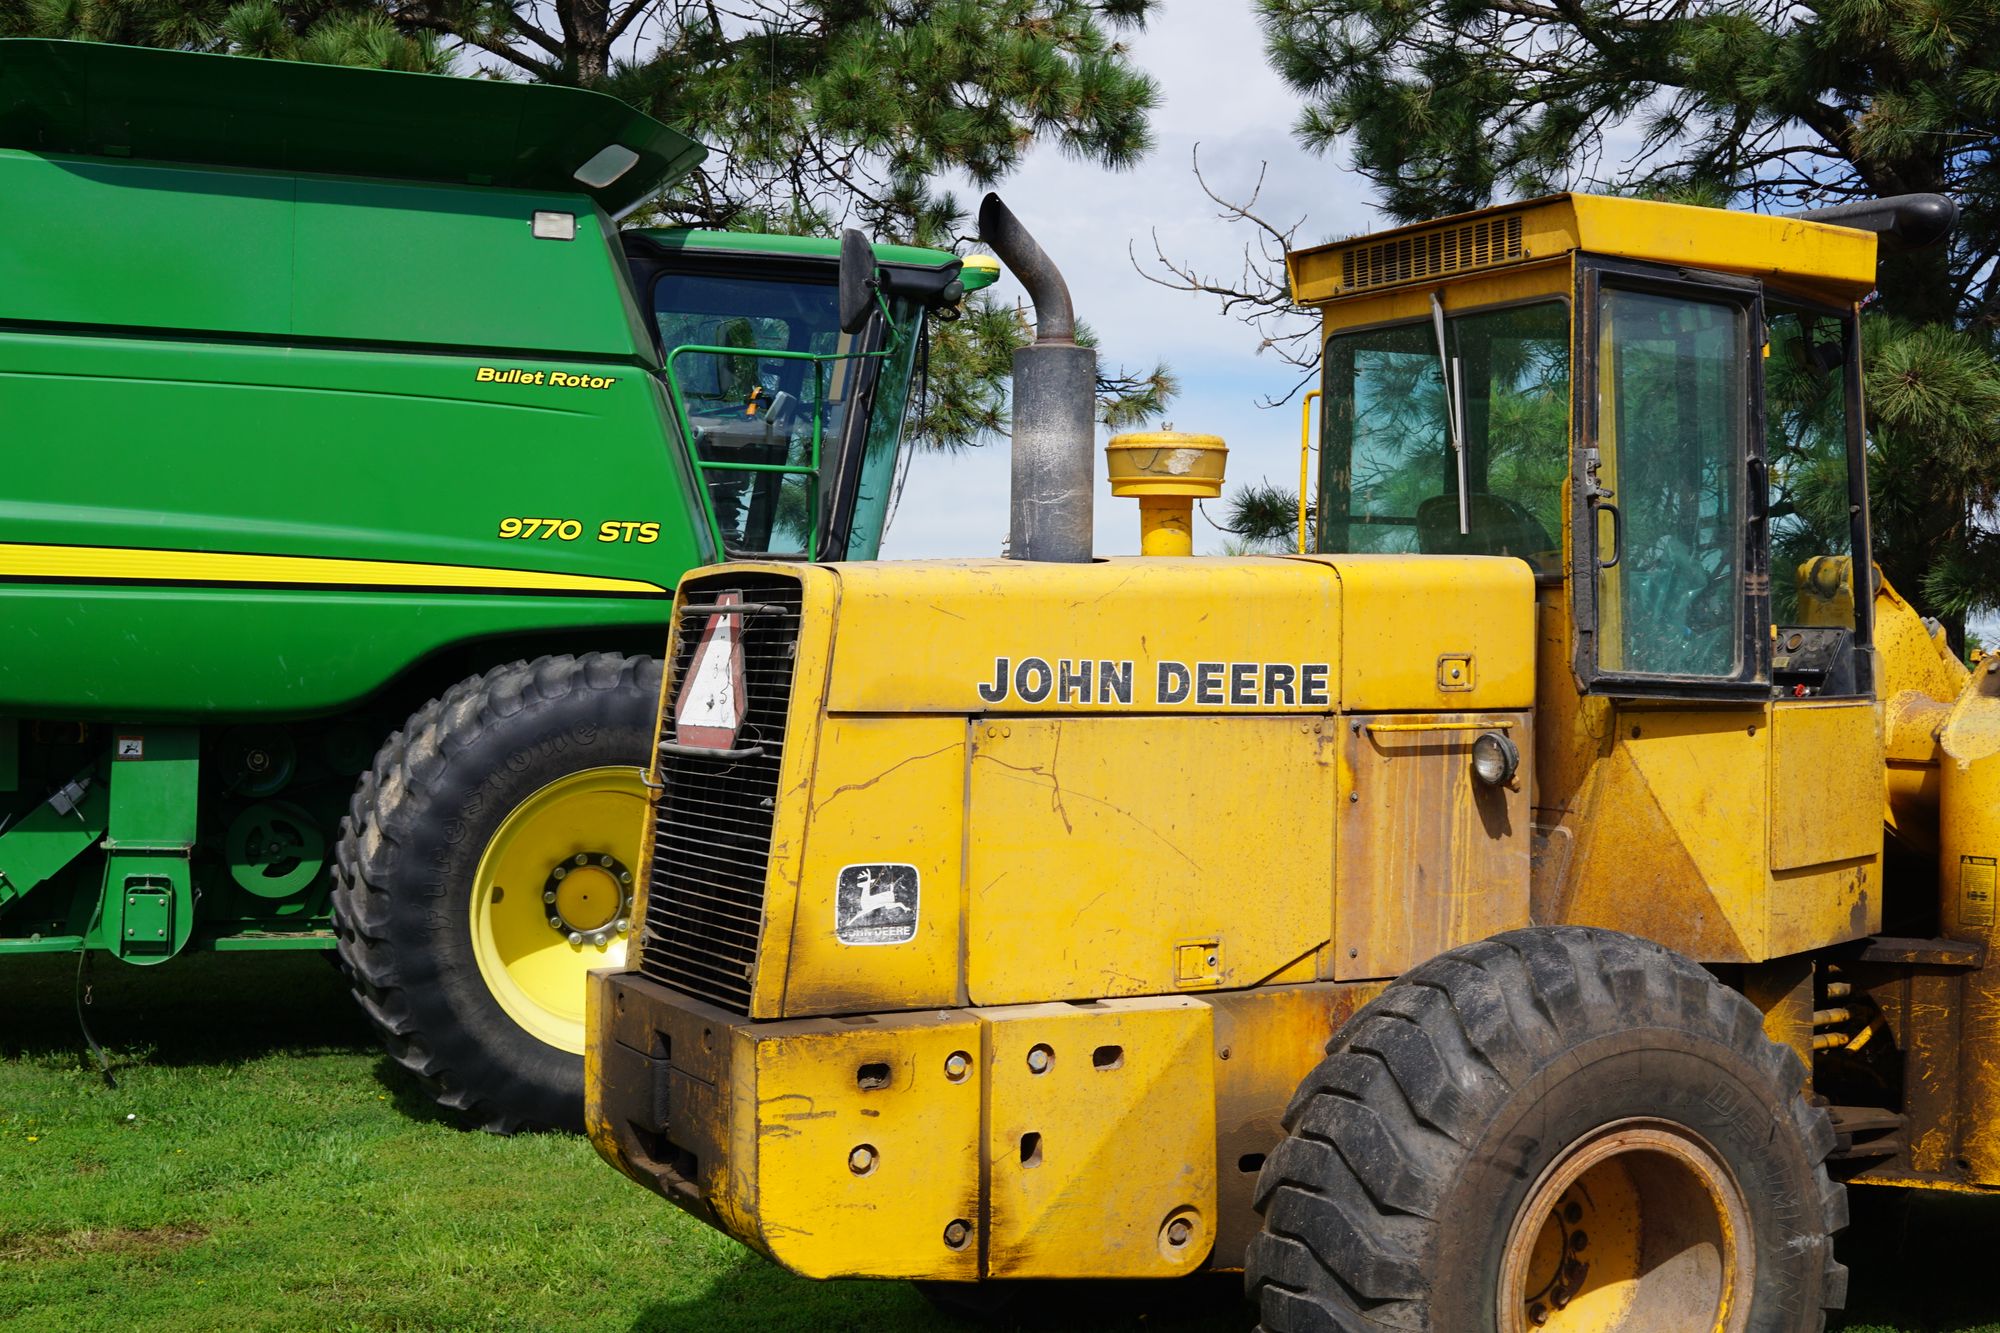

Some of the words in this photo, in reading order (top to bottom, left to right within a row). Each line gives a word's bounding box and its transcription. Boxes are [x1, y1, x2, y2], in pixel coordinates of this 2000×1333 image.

[476, 367, 545, 385] Bullet
[548, 371, 615, 389] Rotor
[498, 517, 583, 541] 9770
[597, 520, 661, 543] STS
[977, 656, 1134, 704] JOHN
[1155, 660, 1331, 707] DEERE
[874, 926, 911, 936] DEERE
